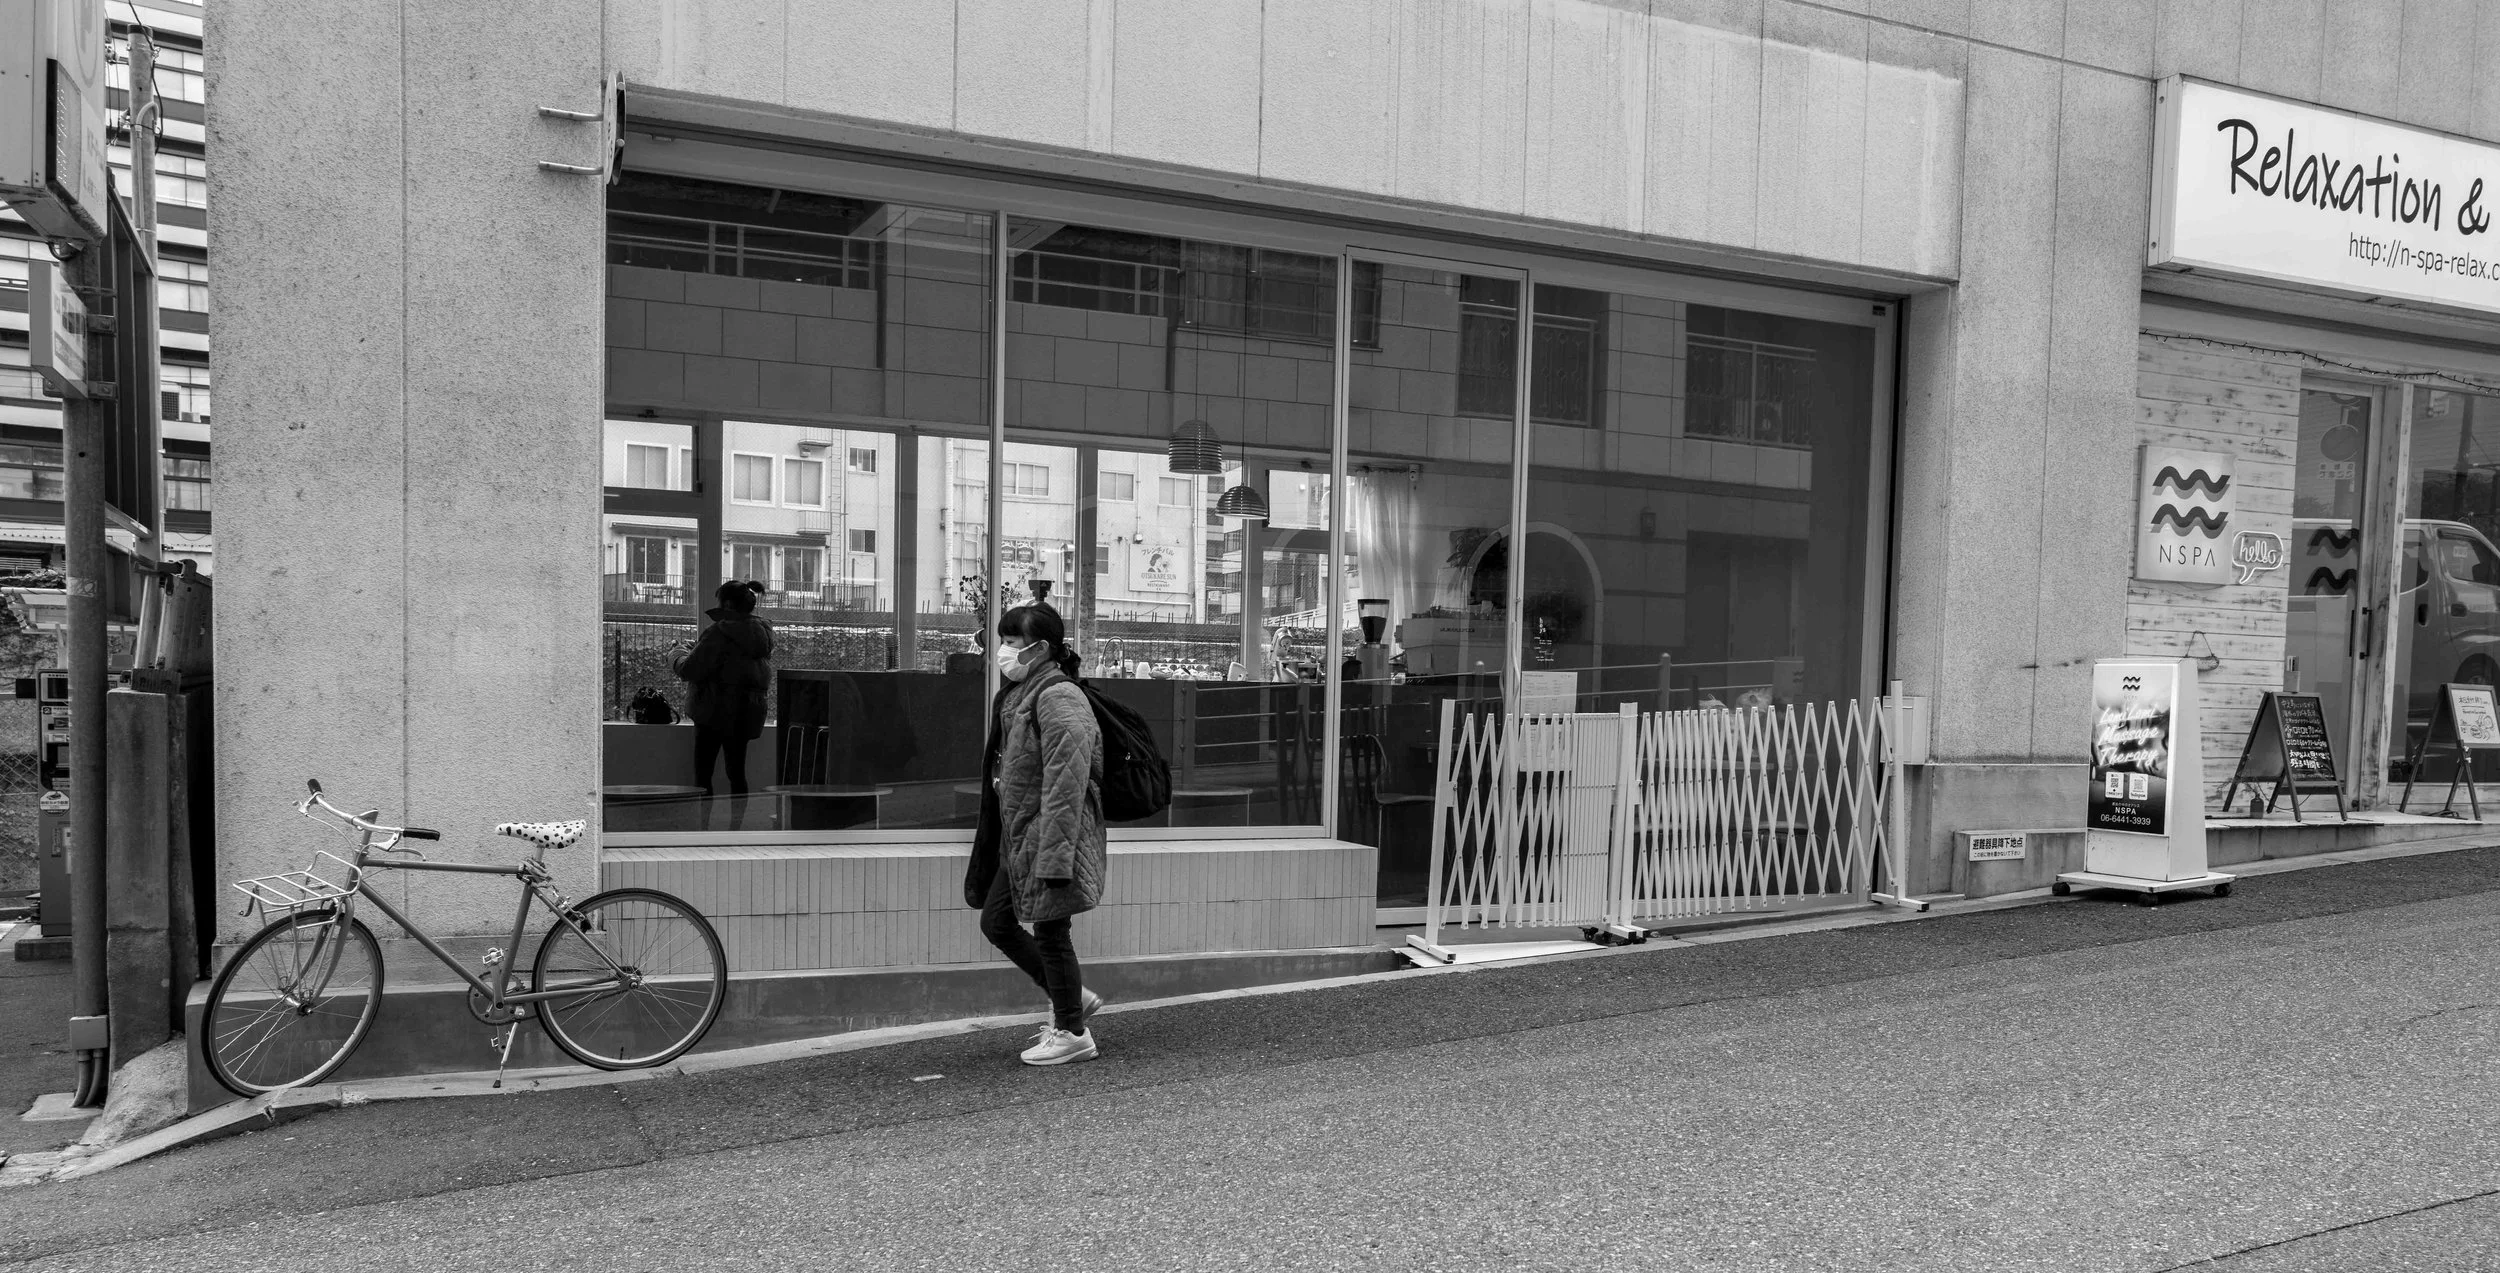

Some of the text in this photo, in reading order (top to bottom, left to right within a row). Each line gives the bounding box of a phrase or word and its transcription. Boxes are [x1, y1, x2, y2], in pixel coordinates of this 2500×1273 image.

[2217, 119, 2490, 235] Relaxation &
[2159, 544, 2216, 567] NSPA
[2239, 536, 2277, 564] hello
[2099, 746, 2160, 768] Therapy
[2100, 813, 2151, 826] 06-6441-3939
[2115, 806, 2137, 815] NSPA
[1972, 837, 2023, 850] 避難器具降下地点
